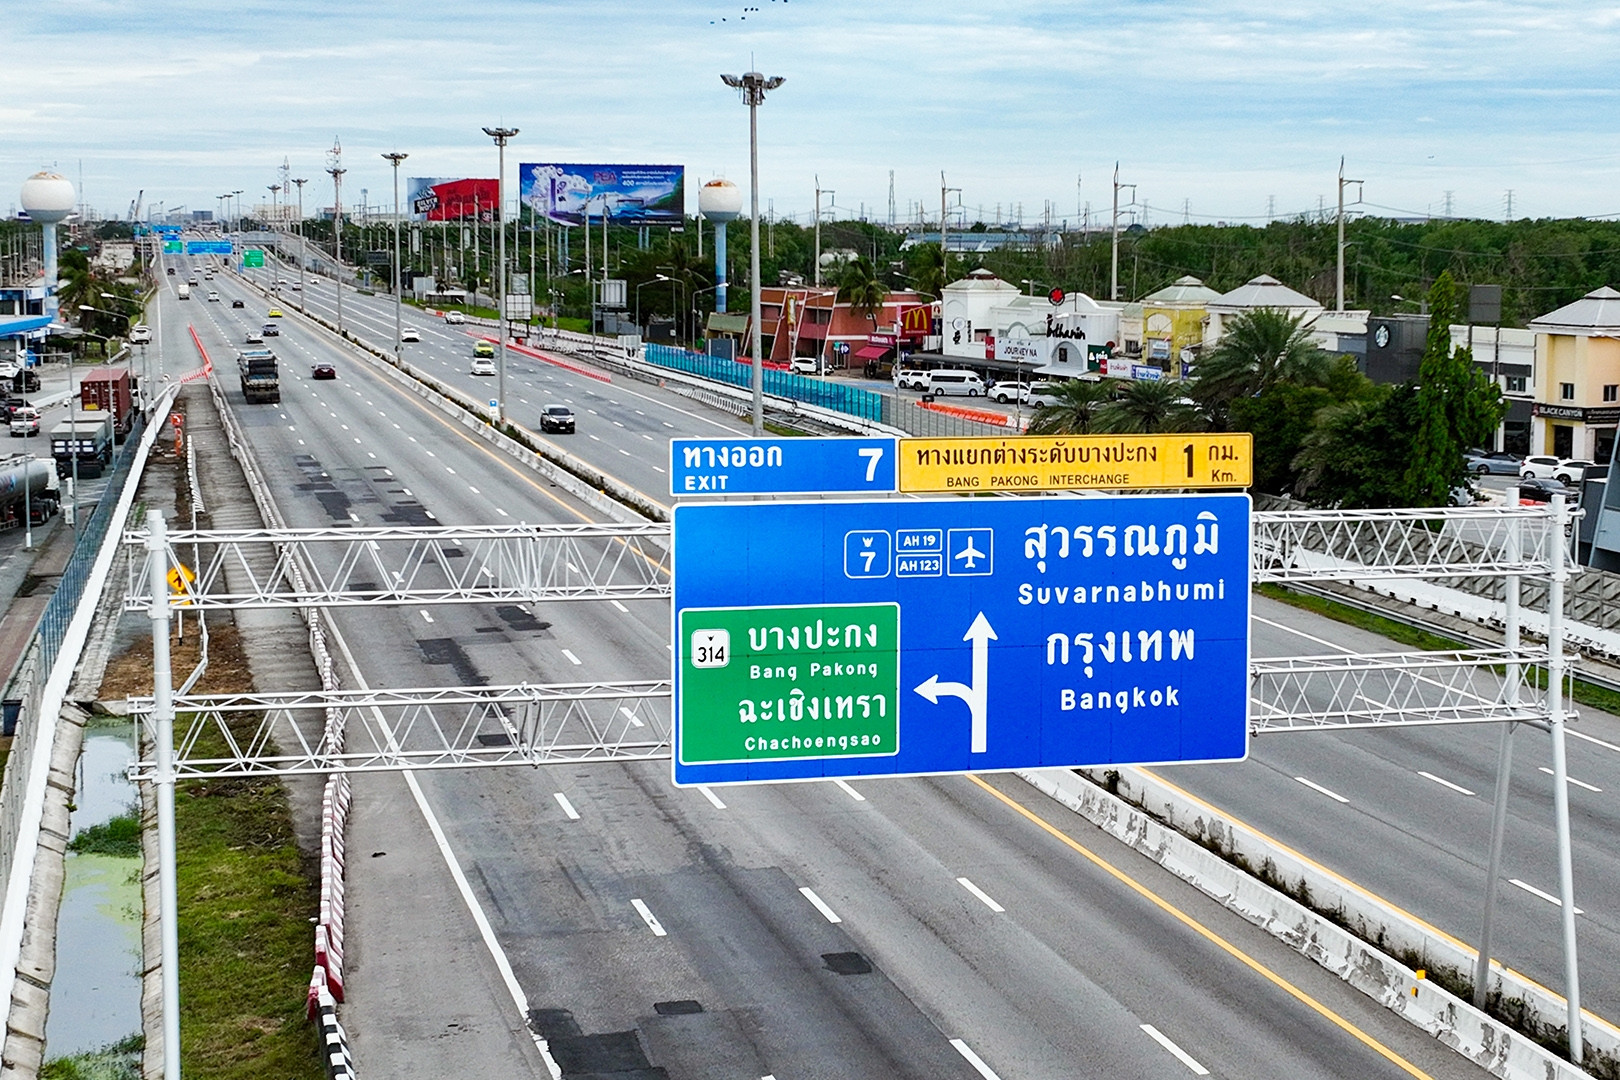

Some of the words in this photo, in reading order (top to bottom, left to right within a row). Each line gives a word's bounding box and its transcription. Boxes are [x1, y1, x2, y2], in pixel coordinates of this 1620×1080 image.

[1539, 406, 1558, 415] BLACK
[1559, 408, 1583, 418] CANYON
[683, 446, 782, 468] ทางออก
[917, 441, 1157, 466] ทางแยกต่างระดับบางปะกง
[1183, 444, 1194, 478] 1
[1209, 445, 1239, 461] กม.
[858, 448, 883, 482] 7
[685, 475, 729, 491] EXIT
[947, 477, 979, 488] BANG
[990, 475, 1039, 487] PAKONG
[1050, 473, 1129, 486] INTERCHANGE
[1212, 469, 1238, 483] Km.
[904, 535, 919, 547] AH
[923, 535, 936, 546] 19
[1024, 511, 1218, 574] สุวรรณภูมิ
[859, 551, 876, 572] 7
[900, 560, 917, 572] AH
[920, 559, 940, 572] 123
[1018, 578, 1225, 605] Suvarnabhumi
[748, 619, 877, 651] บางปะกง
[697, 646, 725, 663] 314
[1047, 628, 1195, 679] กรุงเทพ
[750, 665, 798, 681] Bang
[810, 662, 878, 678] Pakong
[738, 688, 886, 724] ฉะเชิงเทรา
[1061, 685, 1179, 714] Bangkok
[744, 734, 881, 751] Chachoengsao
